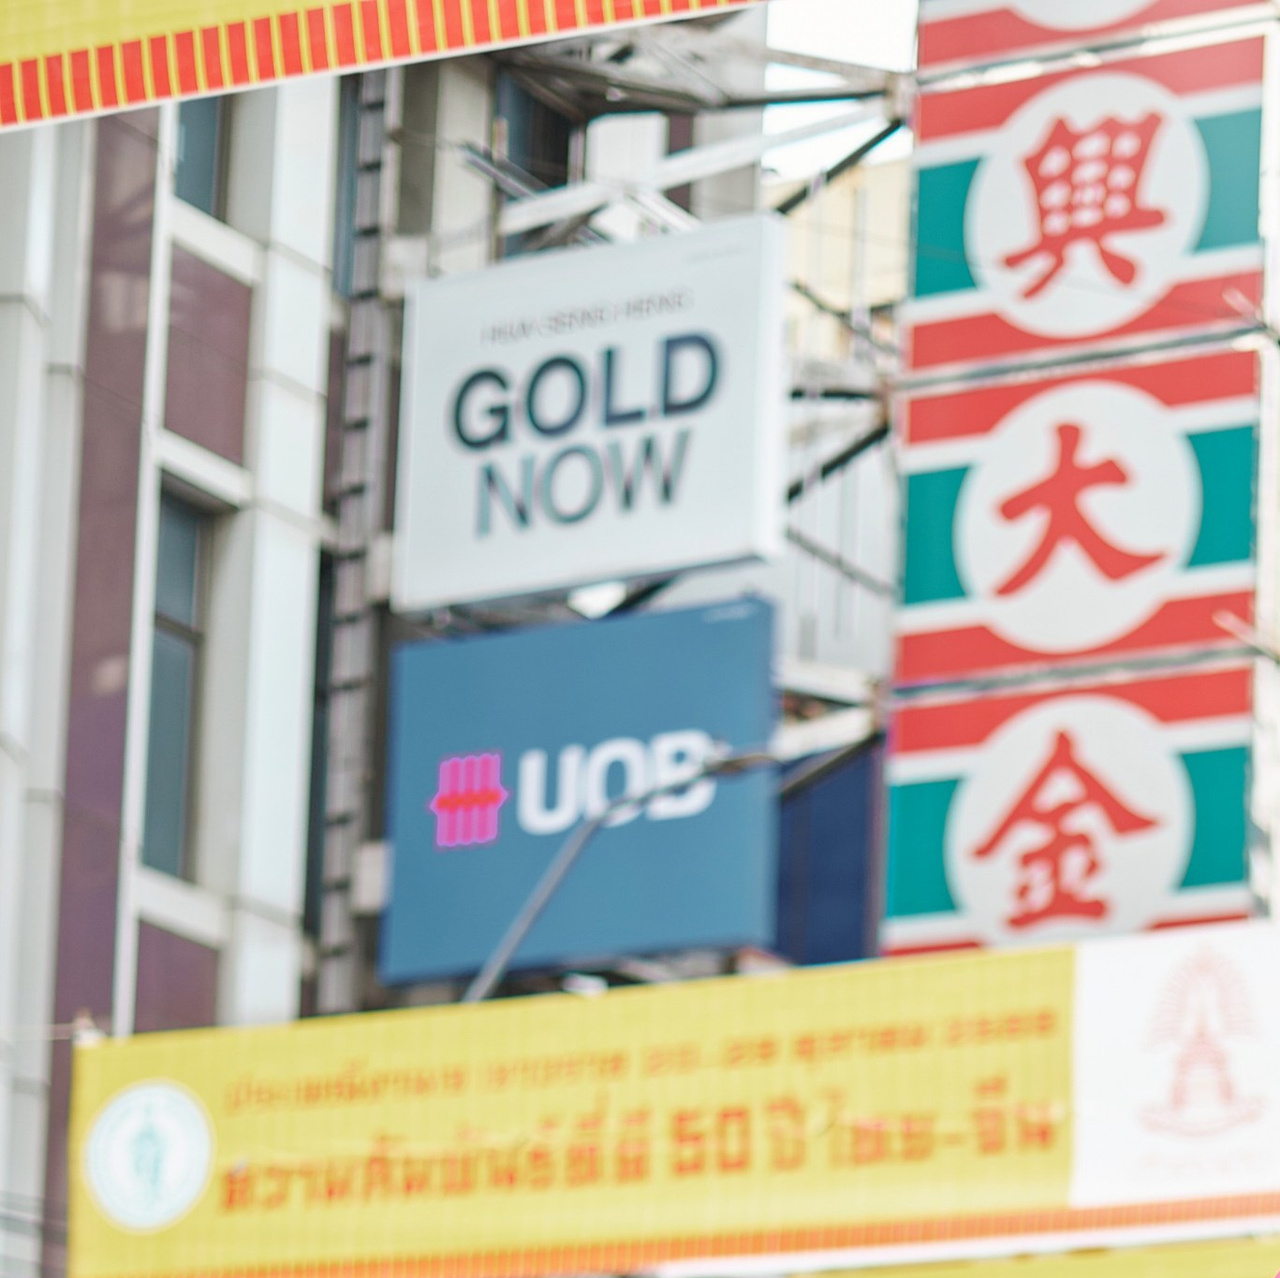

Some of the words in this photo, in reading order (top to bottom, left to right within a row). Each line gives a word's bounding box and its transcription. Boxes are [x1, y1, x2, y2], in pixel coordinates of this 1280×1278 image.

[450, 333, 722, 451] GOLD
[474, 429, 692, 540] NOW
[517, 728, 718, 836] UOB
[670, 1106, 754, 1179] 50
